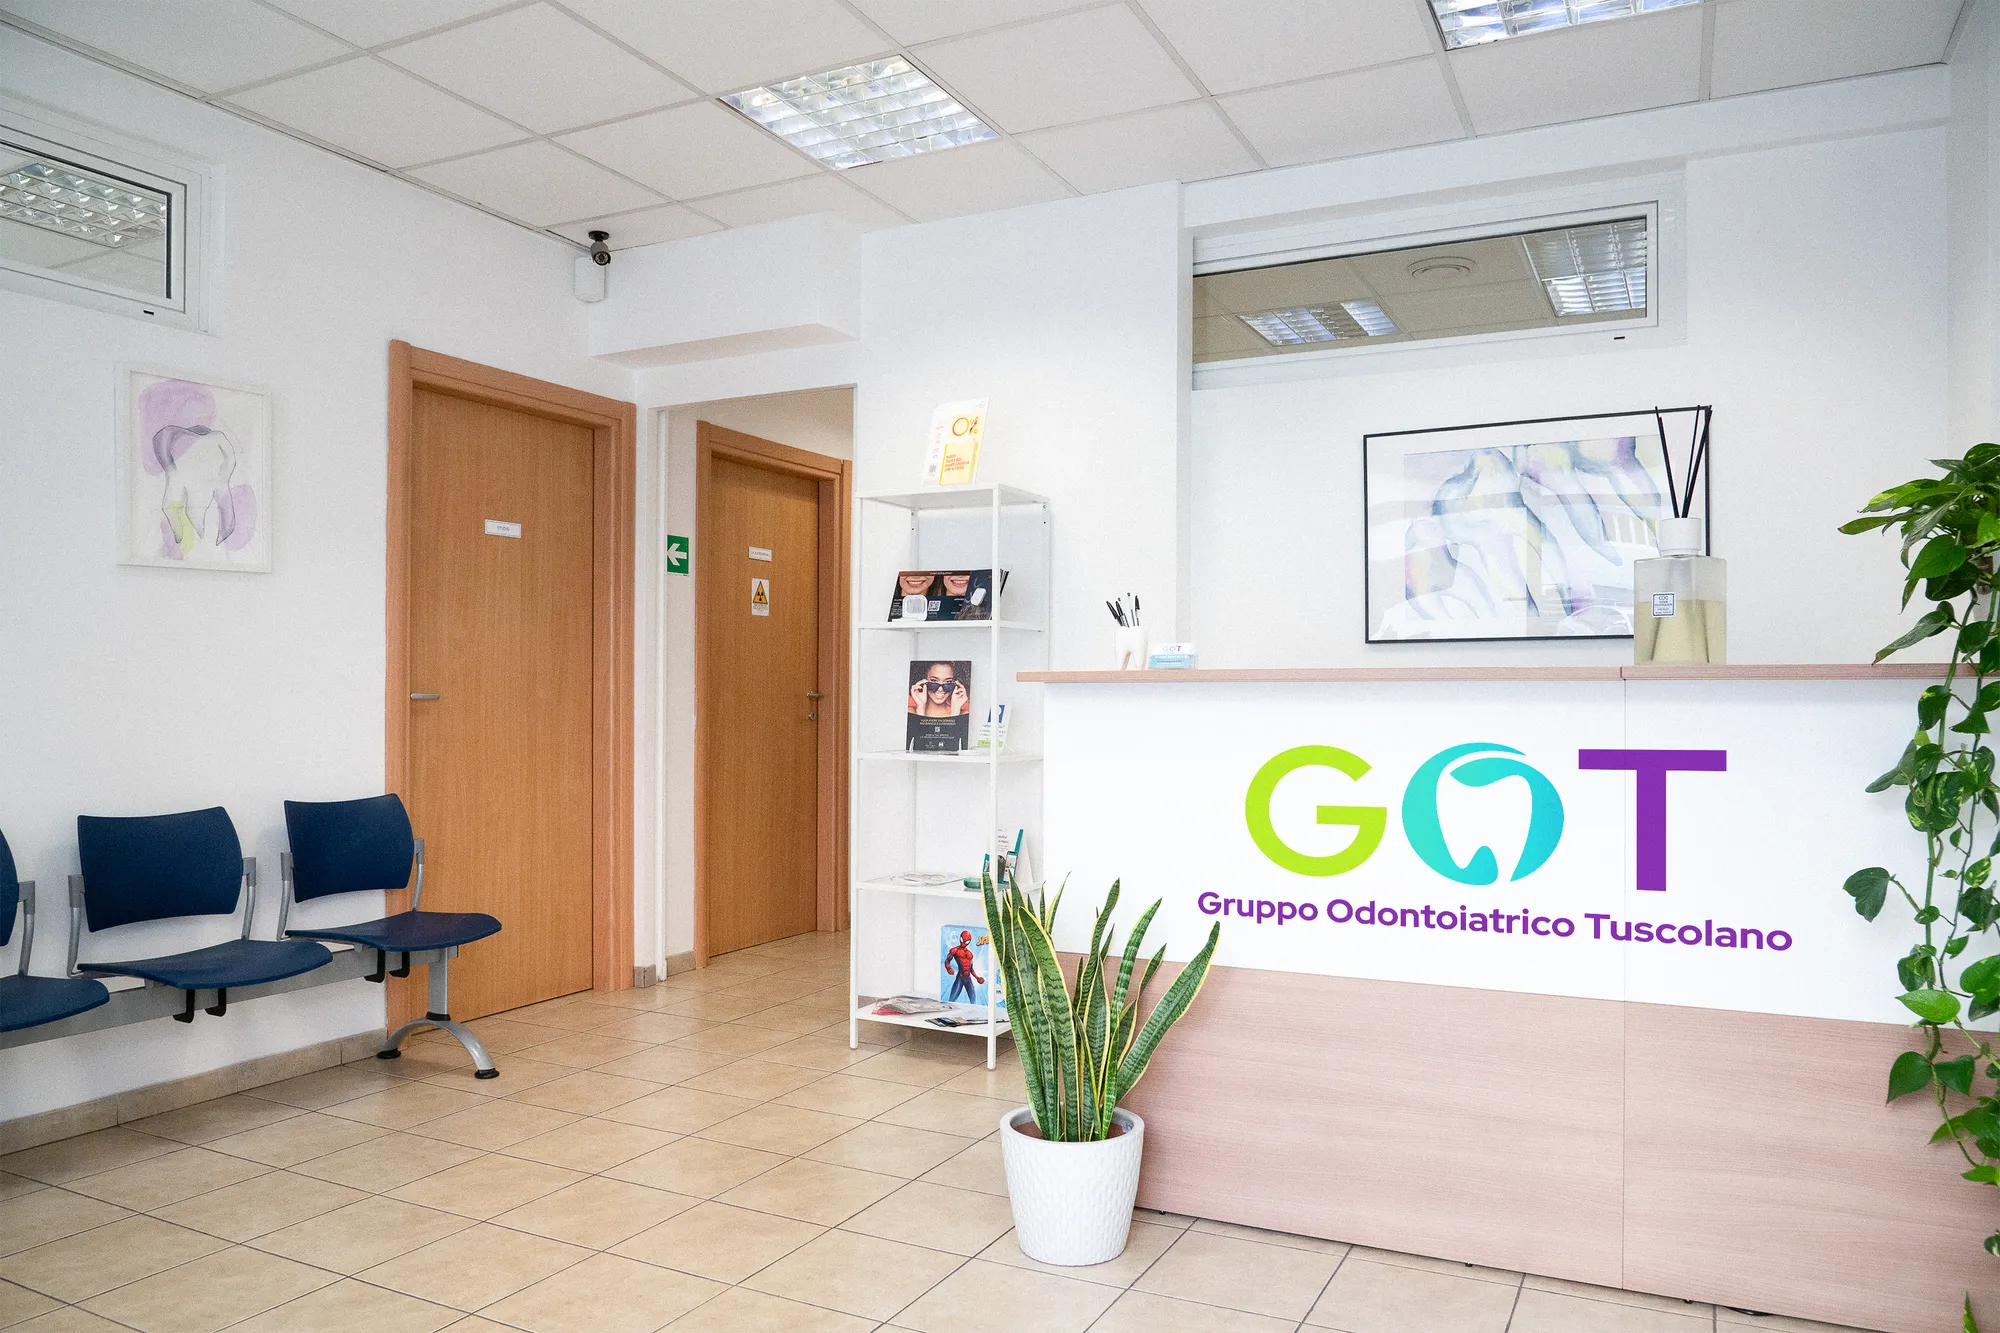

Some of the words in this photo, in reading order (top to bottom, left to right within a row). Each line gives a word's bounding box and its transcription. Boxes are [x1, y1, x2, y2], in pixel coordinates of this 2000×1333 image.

[1245, 742, 1726, 891] GOT
[1198, 892, 1318, 925] Gruppo
[1327, 899, 1574, 937] Odontoiatrico
[1584, 914, 1792, 950] Tuscolano
